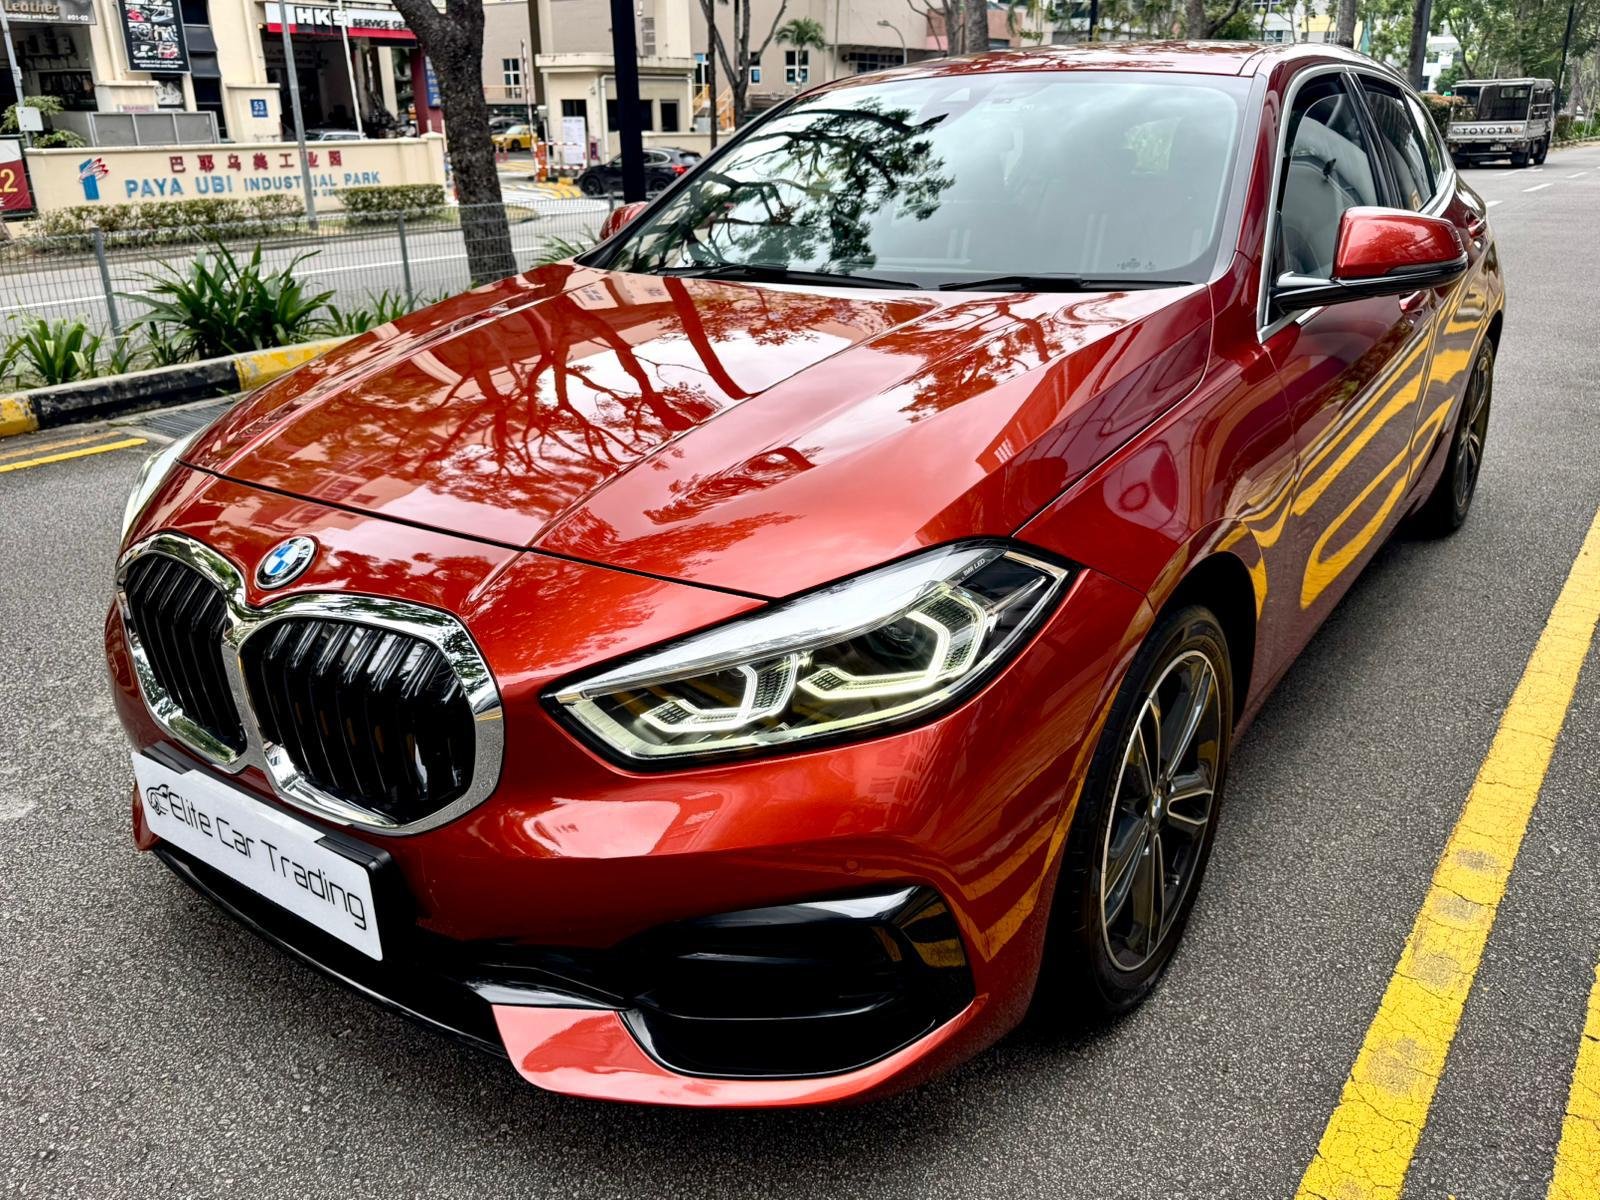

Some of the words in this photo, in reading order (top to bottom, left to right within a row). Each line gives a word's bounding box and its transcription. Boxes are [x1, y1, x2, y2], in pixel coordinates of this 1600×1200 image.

[5, 1, 59, 13] Leather
[295, 7, 347, 26] HKS
[352, 18, 389, 29] SERVICE
[253, 101, 264, 110] 53
[1462, 127, 1512, 135] TOYOTA
[0, 168, 18, 193] 2
[125, 178, 184, 198] PAYA
[195, 175, 233, 194] UBI
[243, 174, 338, 191] INDUSTIAL
[344, 171, 381, 186] PARK
[168, 791, 213, 838] Elite
[216, 816, 255, 859] Car
[260, 839, 368, 932] Trading
